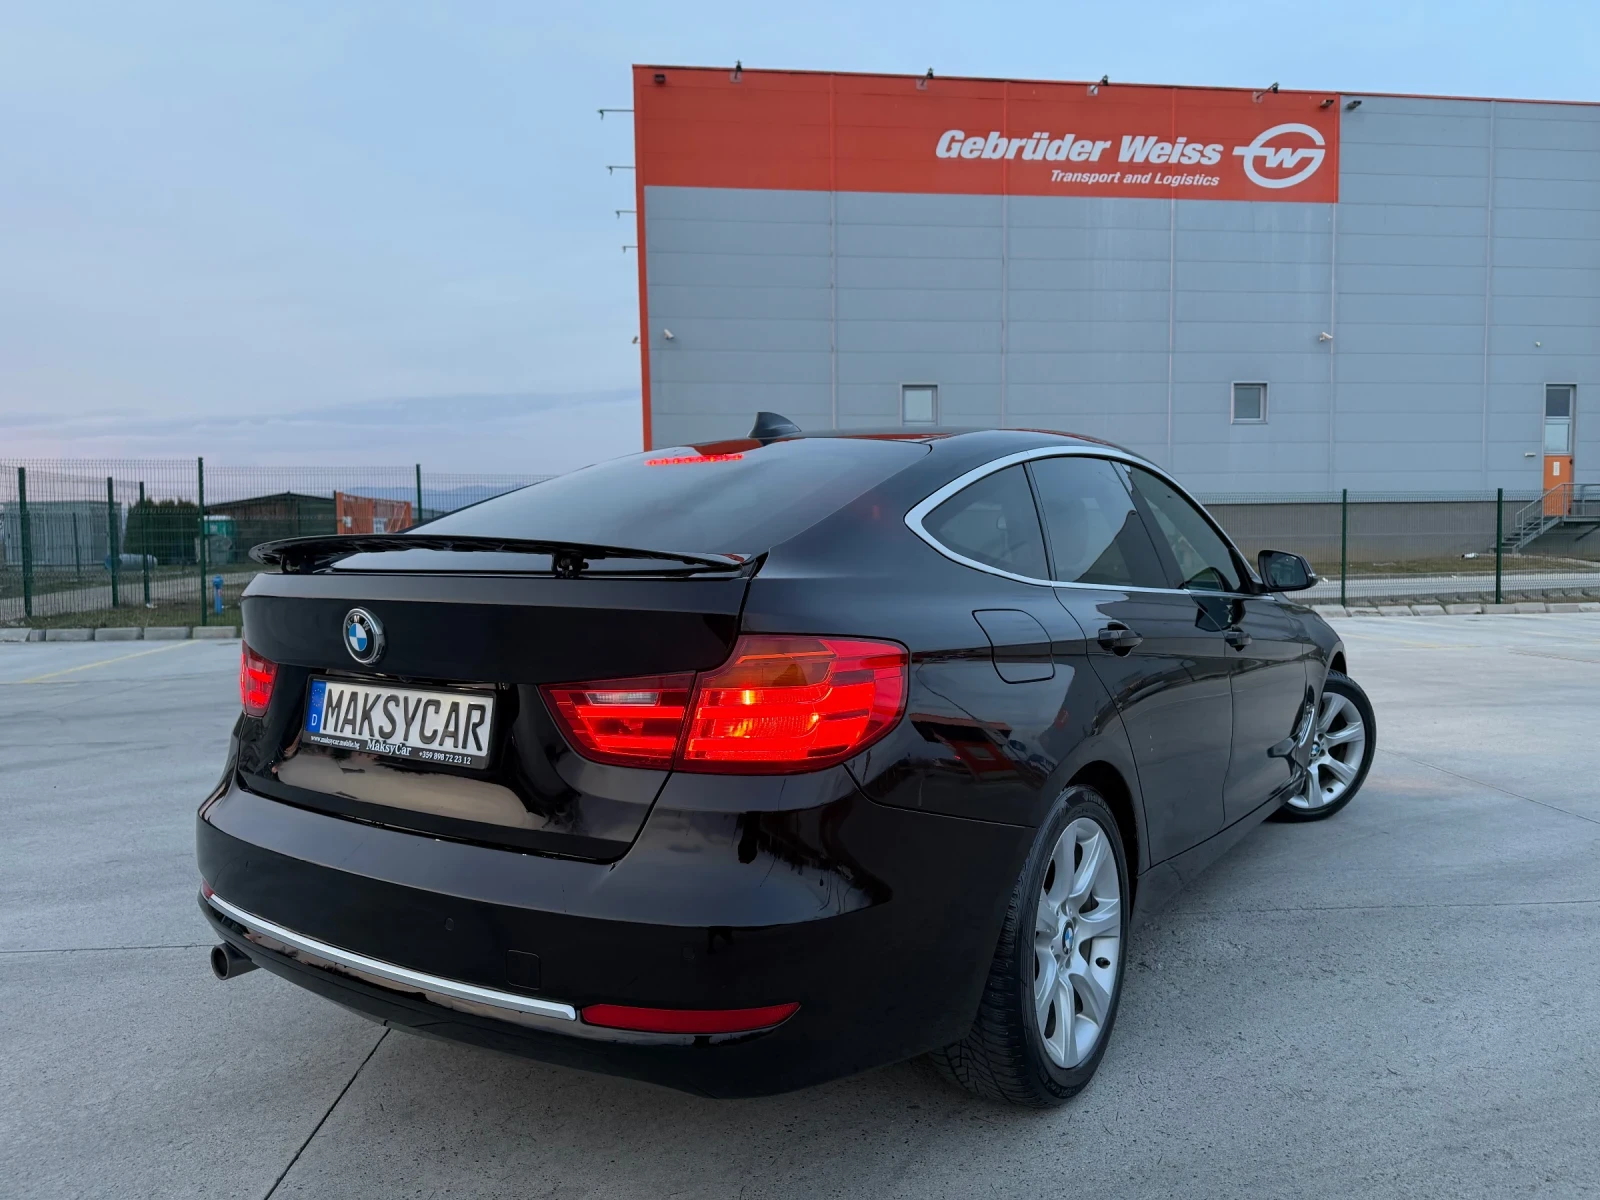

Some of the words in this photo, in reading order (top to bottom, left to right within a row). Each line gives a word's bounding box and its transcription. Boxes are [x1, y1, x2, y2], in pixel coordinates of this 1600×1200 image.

[935, 129, 1111, 163] Gebrüder
[1117, 135, 1224, 165] Weiss
[1050, 169, 1121, 186] Transport
[1123, 172, 1151, 185] and
[1154, 173, 1220, 187] Logistics
[311, 714, 317, 726] D
[322, 688, 486, 751] MAKSYCAR
[366, 739, 412, 756] MaksyCar
[419, 751, 433, 759] +359
[433, 752, 445, 761] 898
[445, 754, 453, 762] 72
[454, 755, 462, 763] 23
[463, 756, 472, 765] 12
